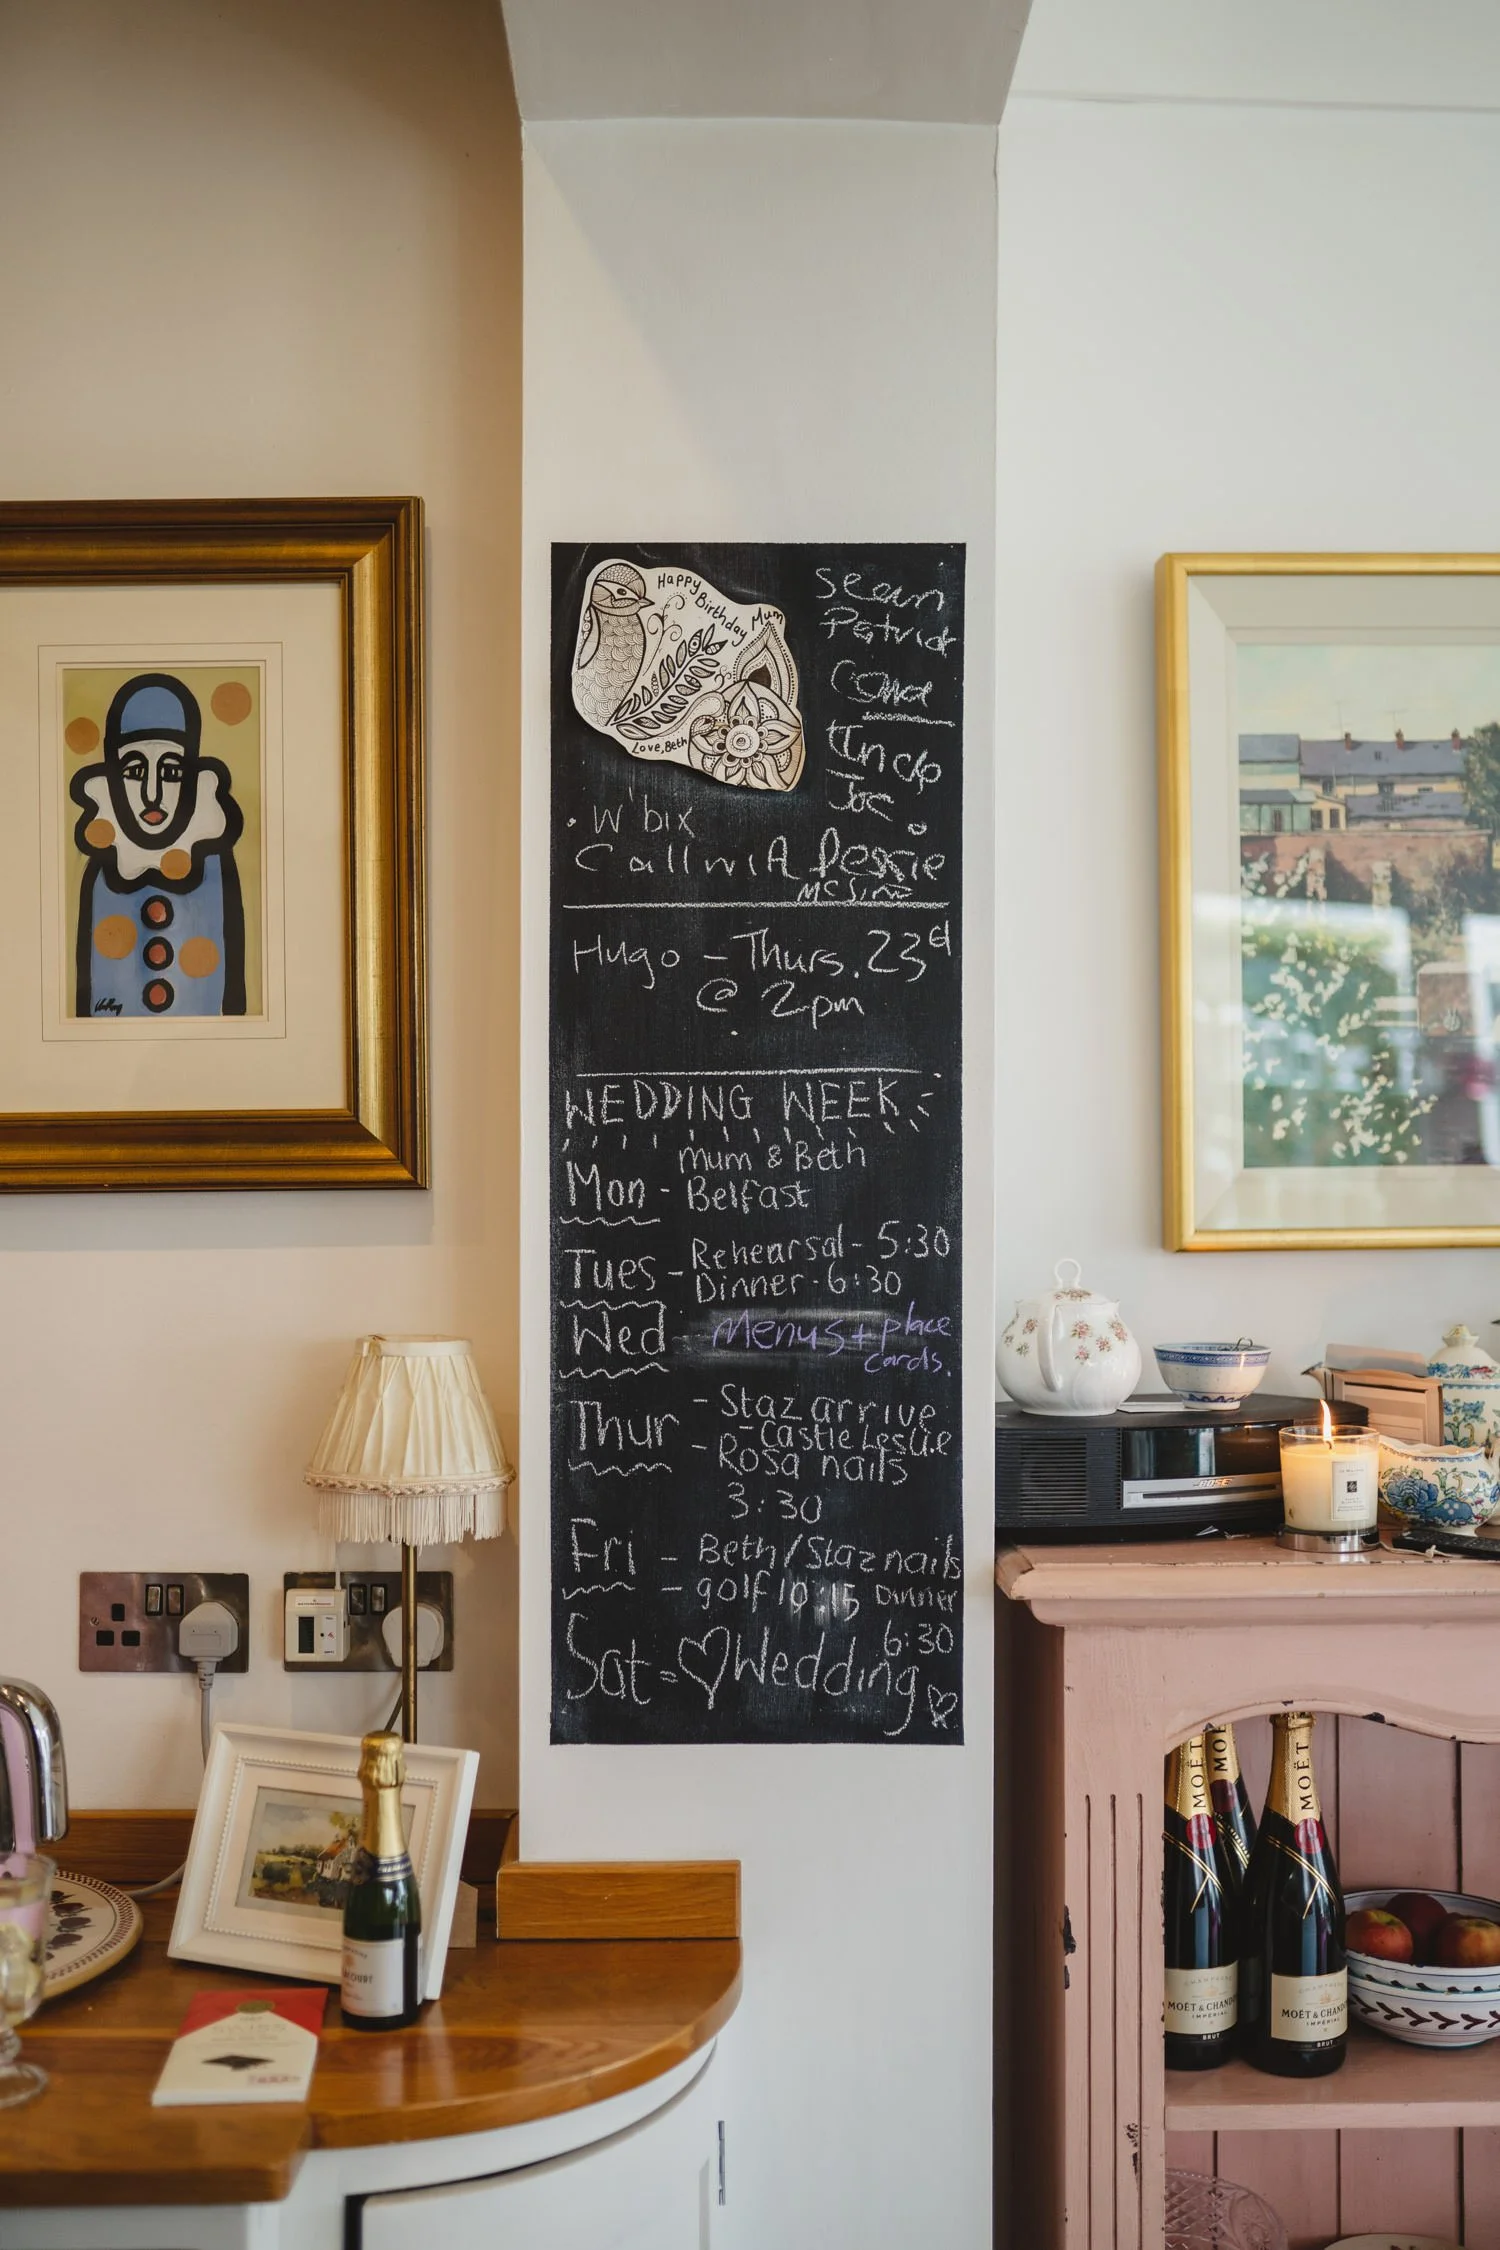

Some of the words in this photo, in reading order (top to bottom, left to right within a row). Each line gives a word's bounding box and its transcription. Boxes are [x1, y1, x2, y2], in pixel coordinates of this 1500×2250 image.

[657, 573, 702, 596] Happy
[695, 592, 748, 647] Birthday
[752, 607, 784, 631] Mum
[815, 567, 945, 612] Sean
[631, 741, 665, 755] Love,
[665, 736, 688, 753] Beth
[574, 934, 680, 989] Hugo
[730, 928, 860, 978] Thurs.
[697, 977, 738, 1013] @
[761, 979, 864, 1030] 2pm
[566, 1080, 753, 1129] WEDDING
[783, 1078, 899, 1123] WEEK
[769, 1146, 783, 1169] &
[795, 1141, 865, 1172] Beth
[566, 1160, 645, 1210] Mon
[688, 1175, 812, 1214] Belfast
[692, 1223, 844, 1270] Rehearsal
[878, 1220, 951, 1260] 5:30
[564, 1248, 656, 1291] Tues
[696, 1270, 803, 1303] Dinner
[827, 1264, 902, 1296] 6:30
[573, 1306, 666, 1355] Wed
[712, 1309, 846, 1357] Menus
[881, 1301, 951, 1354] place
[570, 1400, 680, 1451] Thur
[721, 1383, 802, 1420] Staz
[811, 1396, 936, 1431] arrive
[761, 1420, 853, 1450] Castle
[719, 1433, 800, 1479] Rosa
[822, 1450, 908, 1485] nails
[727, 1481, 823, 1524] 3:30
[571, 1517, 636, 1576] Fri
[885, 1534, 961, 1580] nails
[697, 1569, 770, 1614] golf
[876, 1583, 958, 1613] Dinner
[883, 1619, 954, 1657] 6:30
[566, 1612, 651, 1705] Sat
[734, 1625, 920, 1737] Wedding
[1212, 1724, 1228, 1772] MO
[1294, 1742, 1315, 1811] MOËT
